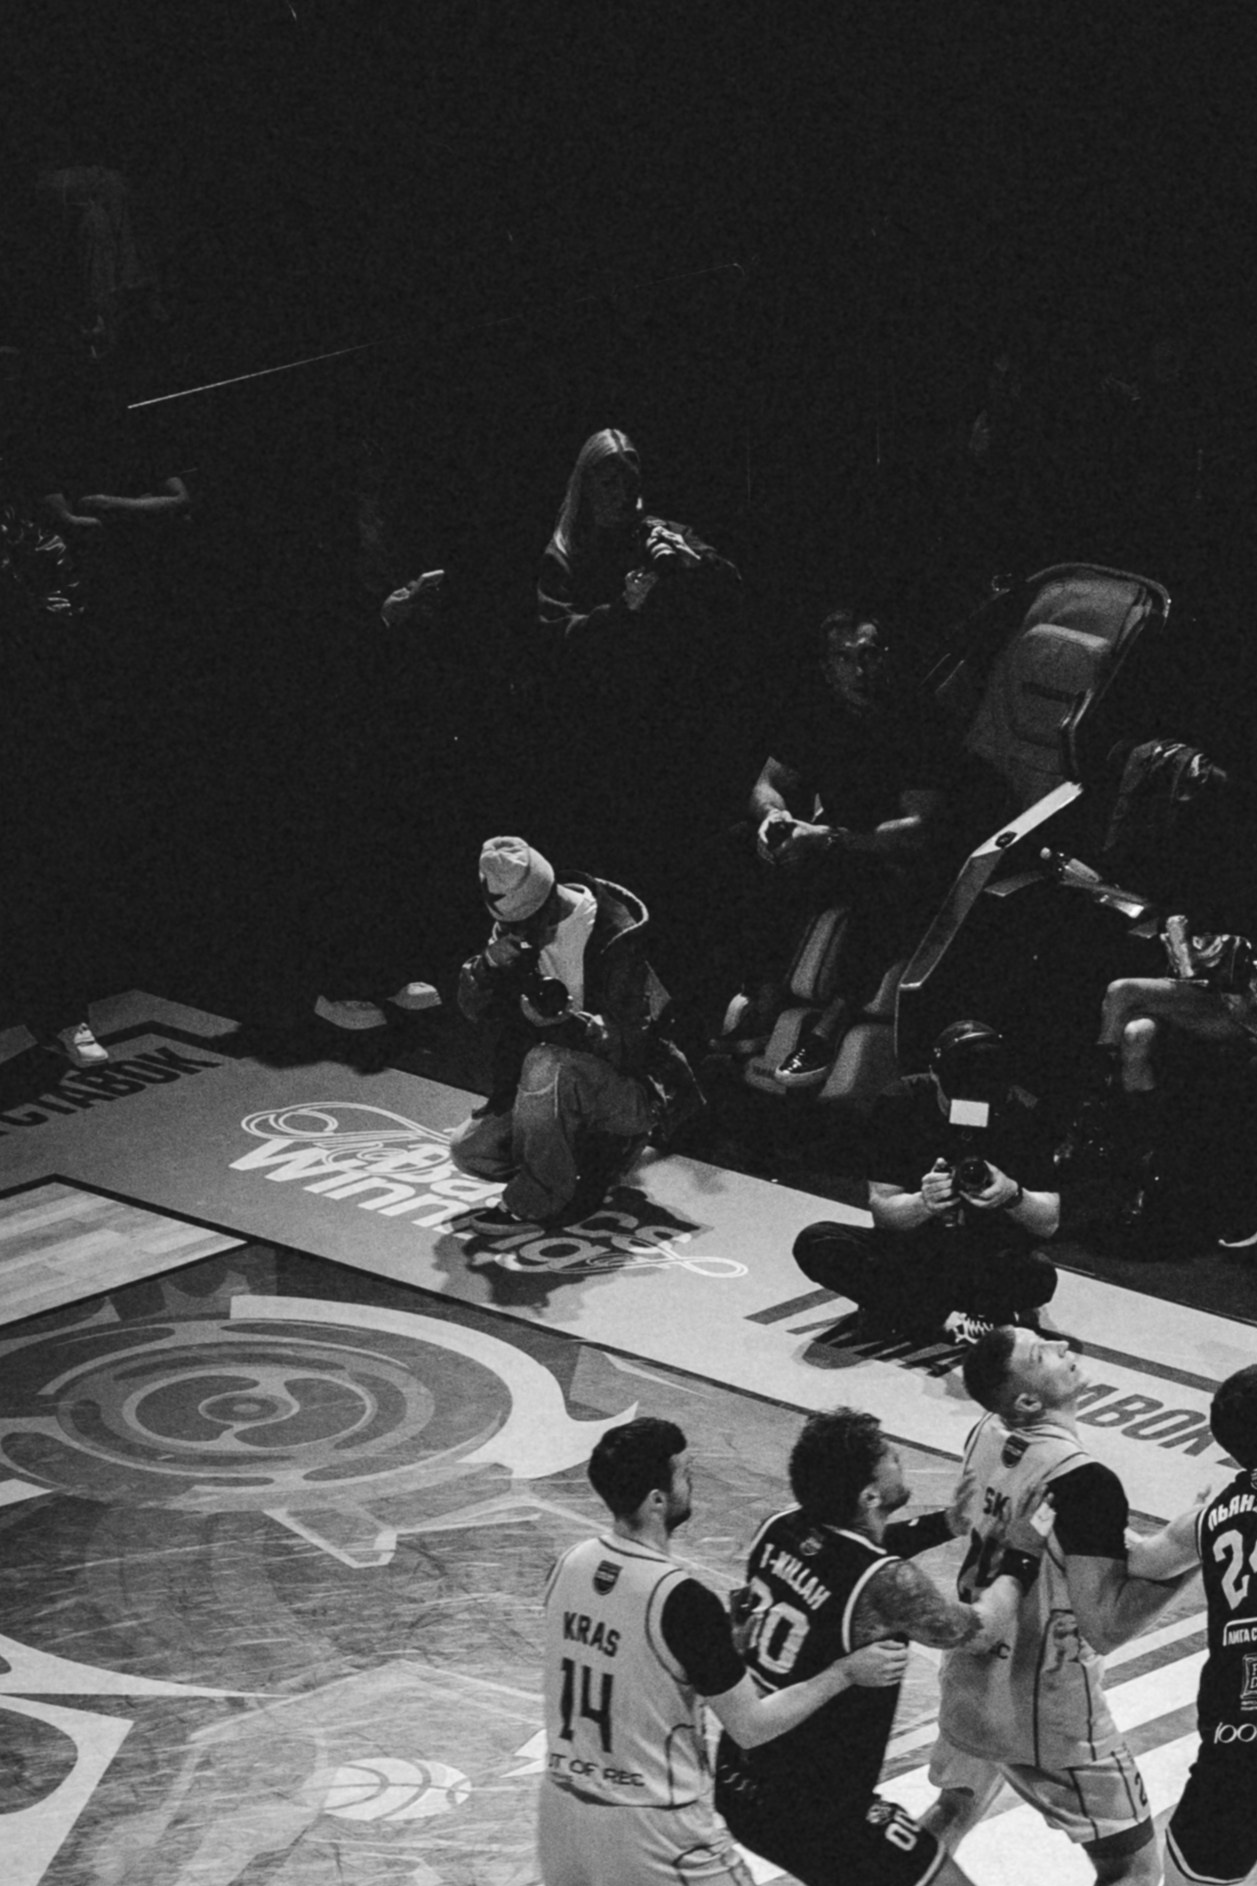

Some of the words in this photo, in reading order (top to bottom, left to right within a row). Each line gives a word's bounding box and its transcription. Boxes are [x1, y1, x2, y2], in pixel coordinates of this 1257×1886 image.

[563, 1611, 622, 1658] KRAS
[1228, 1628, 1251, 1646] ЛИГА
[559, 1656, 615, 1754] 14
[569, 1759, 599, 1777] OF
